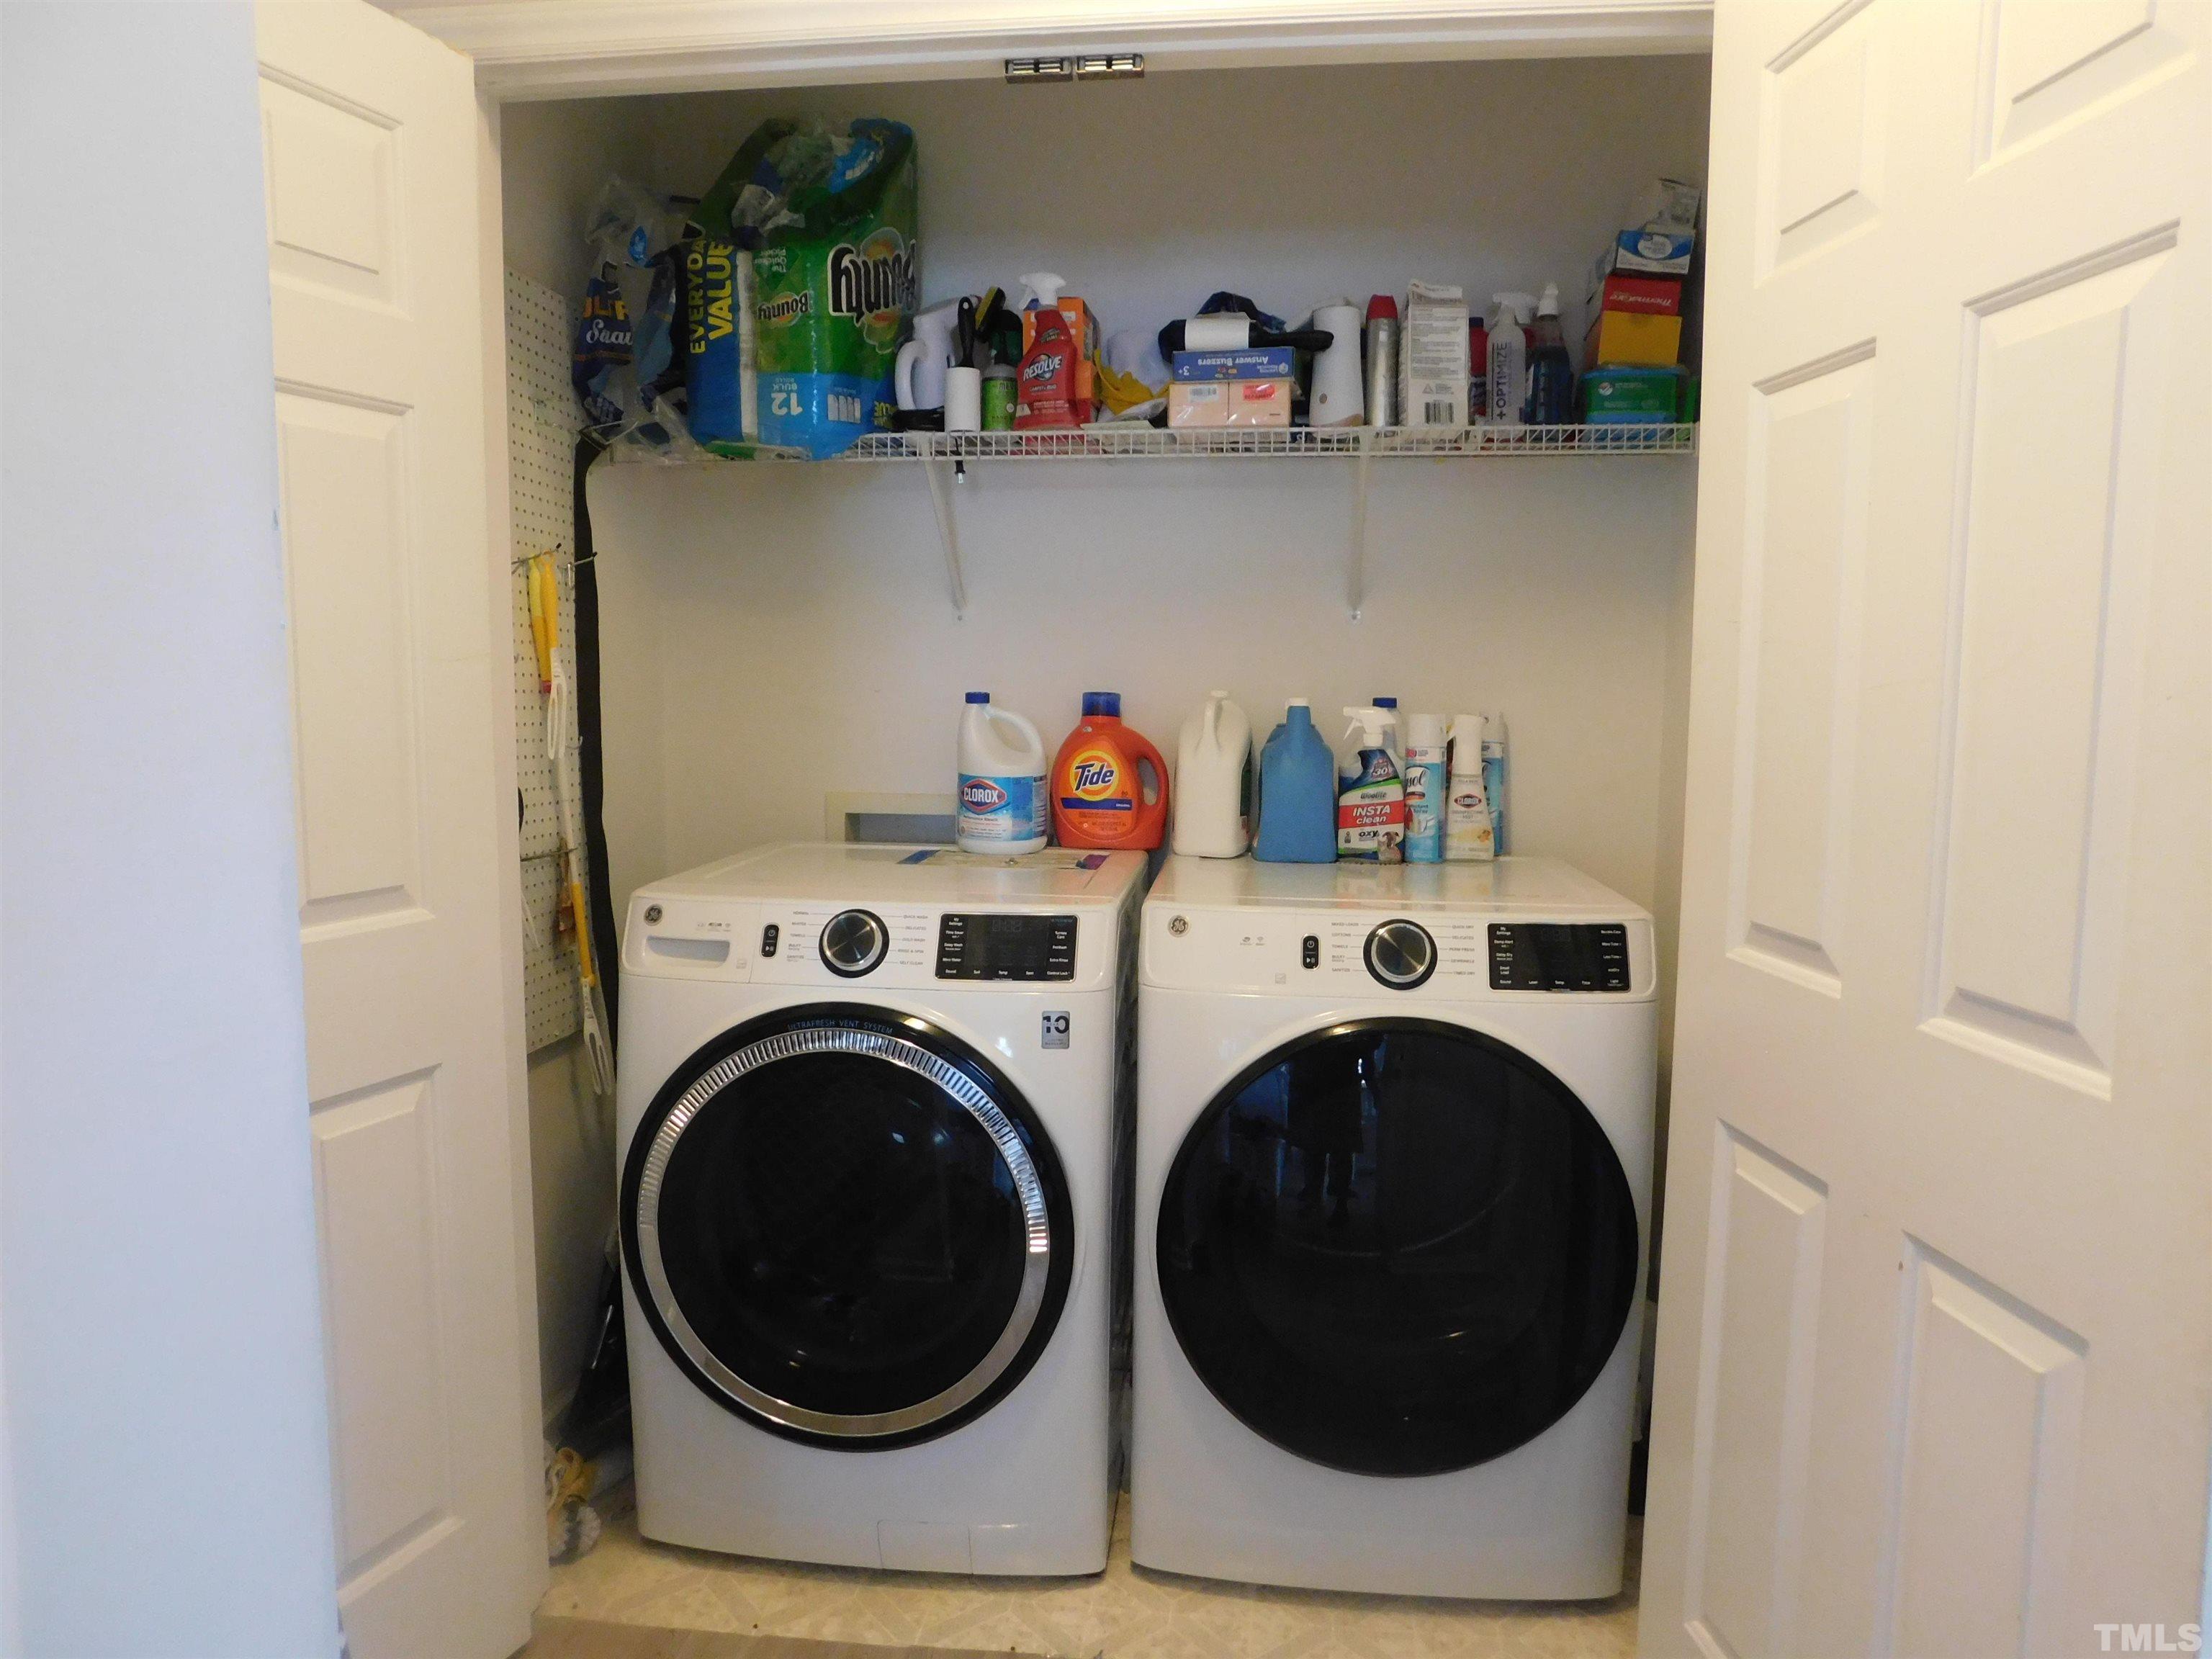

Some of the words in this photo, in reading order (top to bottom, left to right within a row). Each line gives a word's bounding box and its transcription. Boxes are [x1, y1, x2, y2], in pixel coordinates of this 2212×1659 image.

[828, 239, 916, 325] Bounty
[706, 241, 734, 341] VALUE
[756, 292, 809, 322] Bounty
[1022, 354, 1063, 382] RESOLVE
[1197, 358, 1233, 367] Buzzers
[1234, 356, 1269, 365] Answer
[1178, 365, 1190, 376] 3+
[771, 392, 803, 415] 12
[1074, 762, 1115, 792] Tide
[963, 787, 999, 804] CLOROX
[1360, 791, 1388, 800] Woolite
[1353, 805, 1390, 817] INSTA
[1356, 815, 1387, 824] clean
[1359, 830, 1378, 838] oxy
[788, 1019, 835, 1031] ULTRAFRESH
[838, 1020, 860, 1028] VENT
[863, 1021, 894, 1034] SYSTEM
[1043, 1015, 1069, 1034] 10
